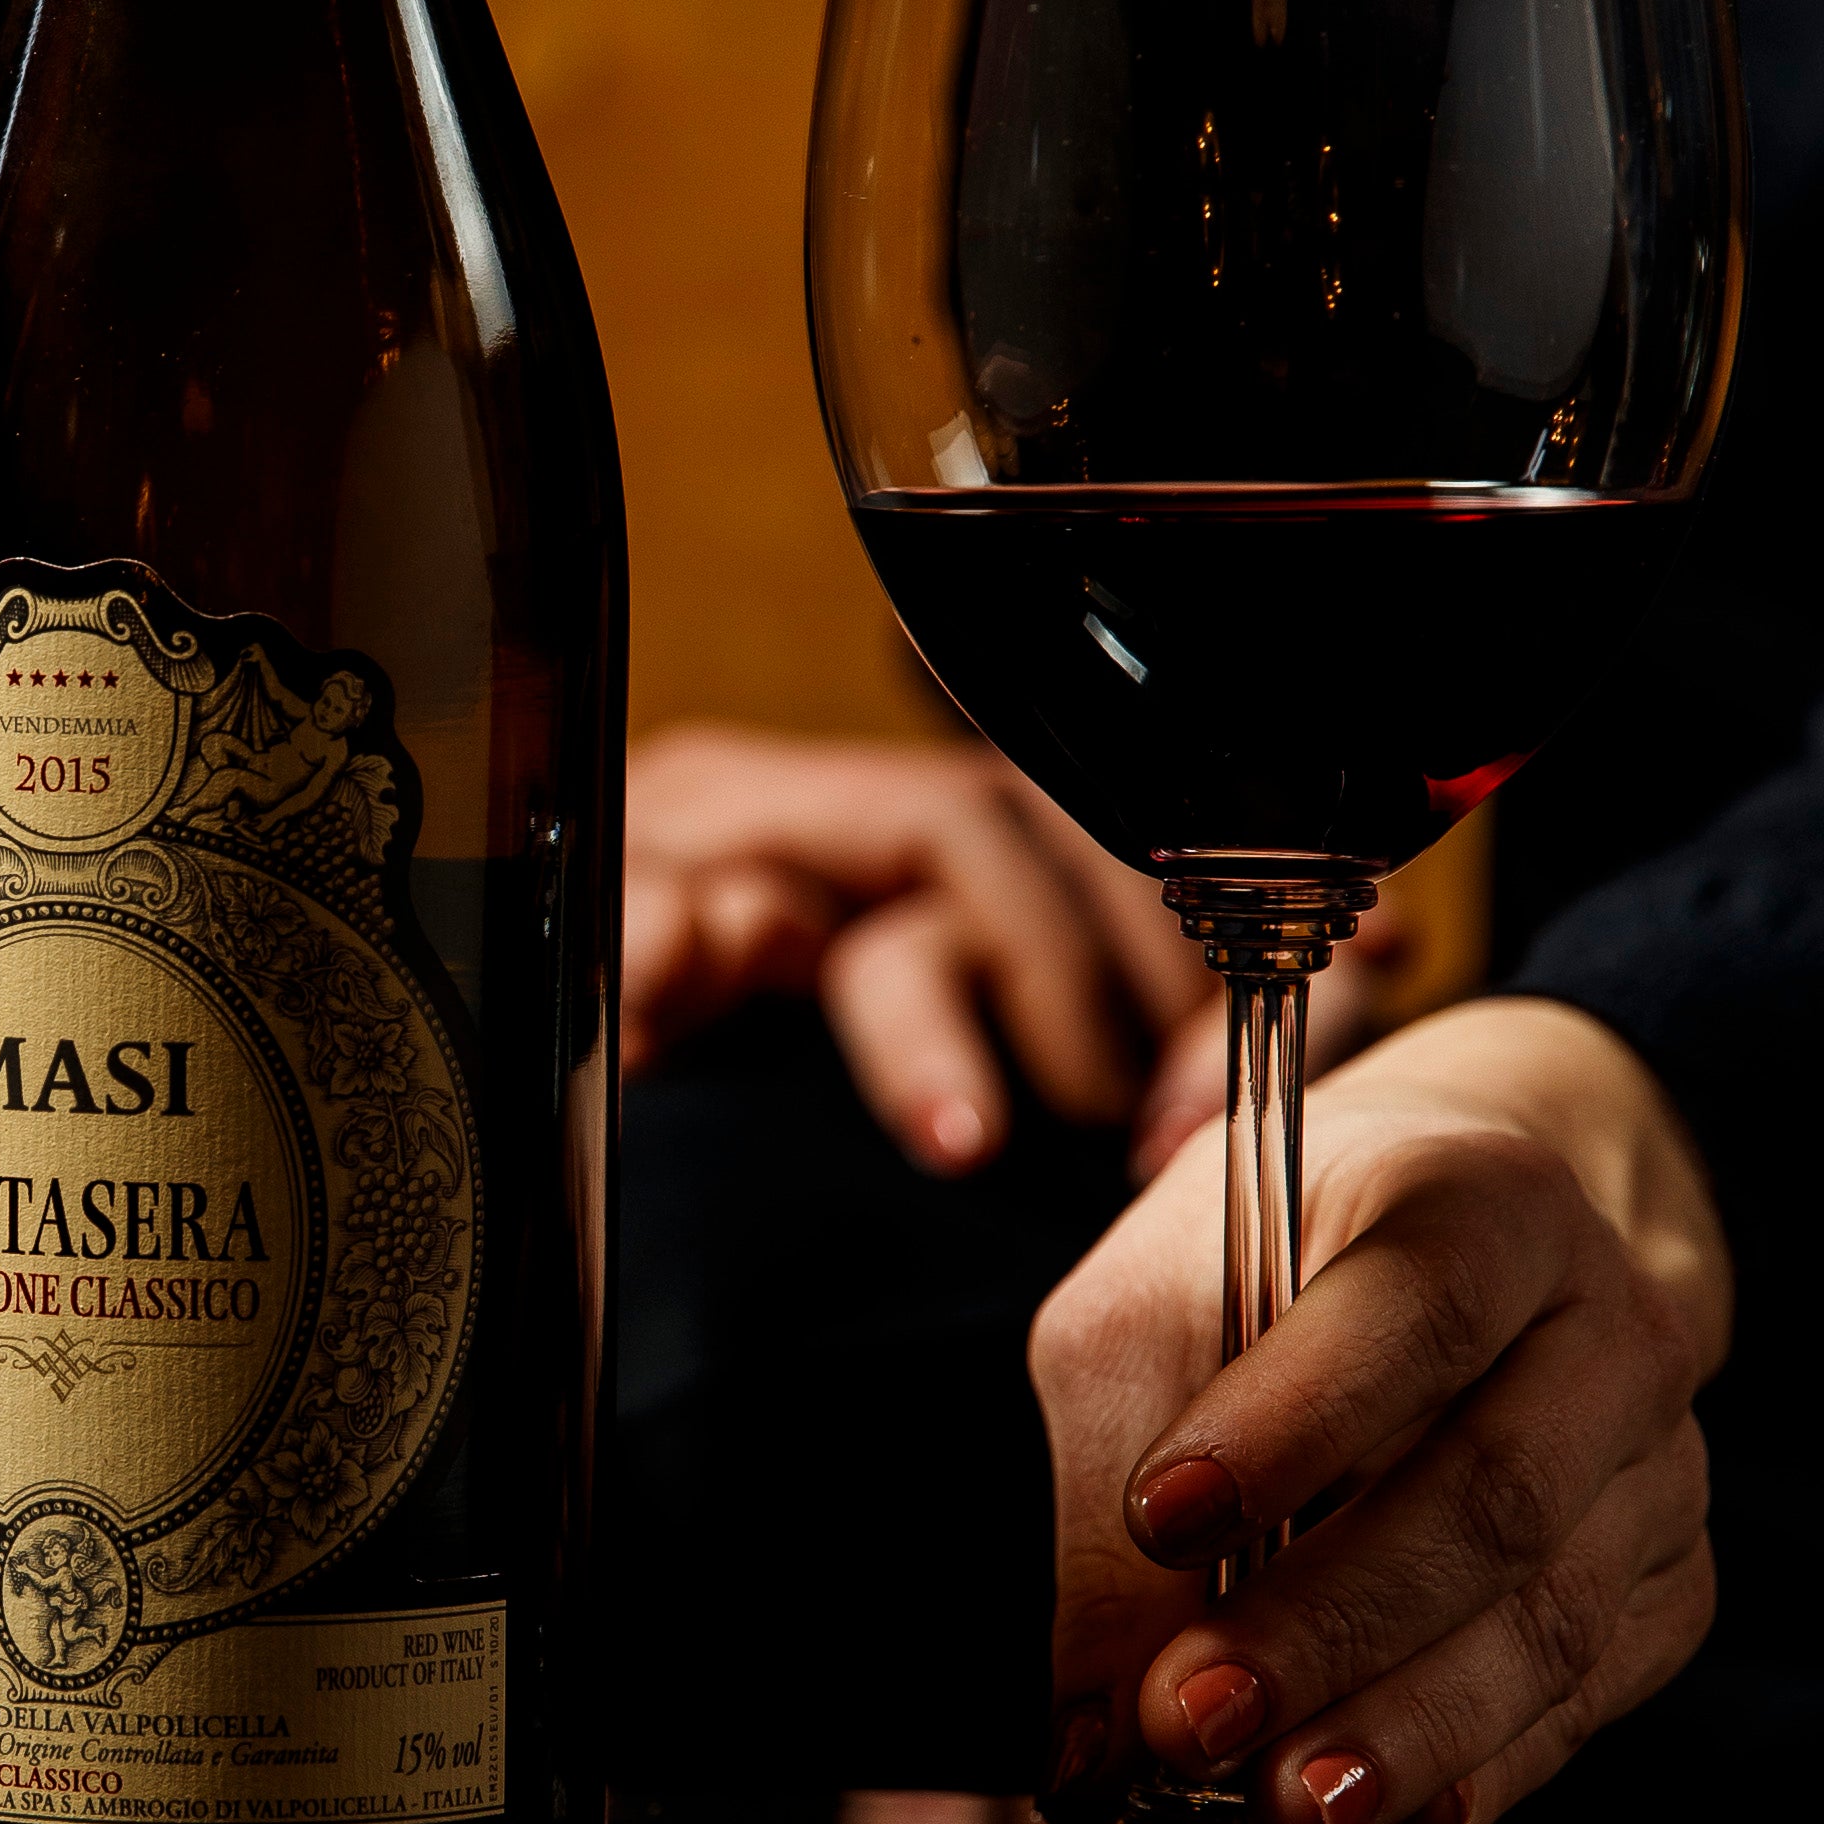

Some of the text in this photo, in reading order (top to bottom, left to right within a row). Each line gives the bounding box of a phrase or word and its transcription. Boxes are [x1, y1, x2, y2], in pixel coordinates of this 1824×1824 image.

[0, 715, 137, 736] VENDEMMIA
[15, 753, 111, 795] 2015
[70, 1275, 261, 1322] CLASSICO
[403, 1628, 485, 1658] RED WINE
[489, 1616, 500, 1655] 10/20
[316, 1656, 486, 1692] PRODUCT OF ITALY
[83, 1711, 290, 1738] VALPOLICELLA
[80, 1739, 204, 1765] Controllata
[211, 1750, 223, 1765] e
[231, 1742, 339, 1766] Garantita
[393, 1722, 485, 1776] 15% vol
[20, 1792, 56, 1814] SPA
[60, 1794, 76, 1815] S.
[82, 1796, 209, 1820] AMBROGIO
[215, 1799, 240, 1819] DI
[245, 1793, 407, 1818] VALPOLICELLA
[423, 1785, 485, 1811] ITALIA
